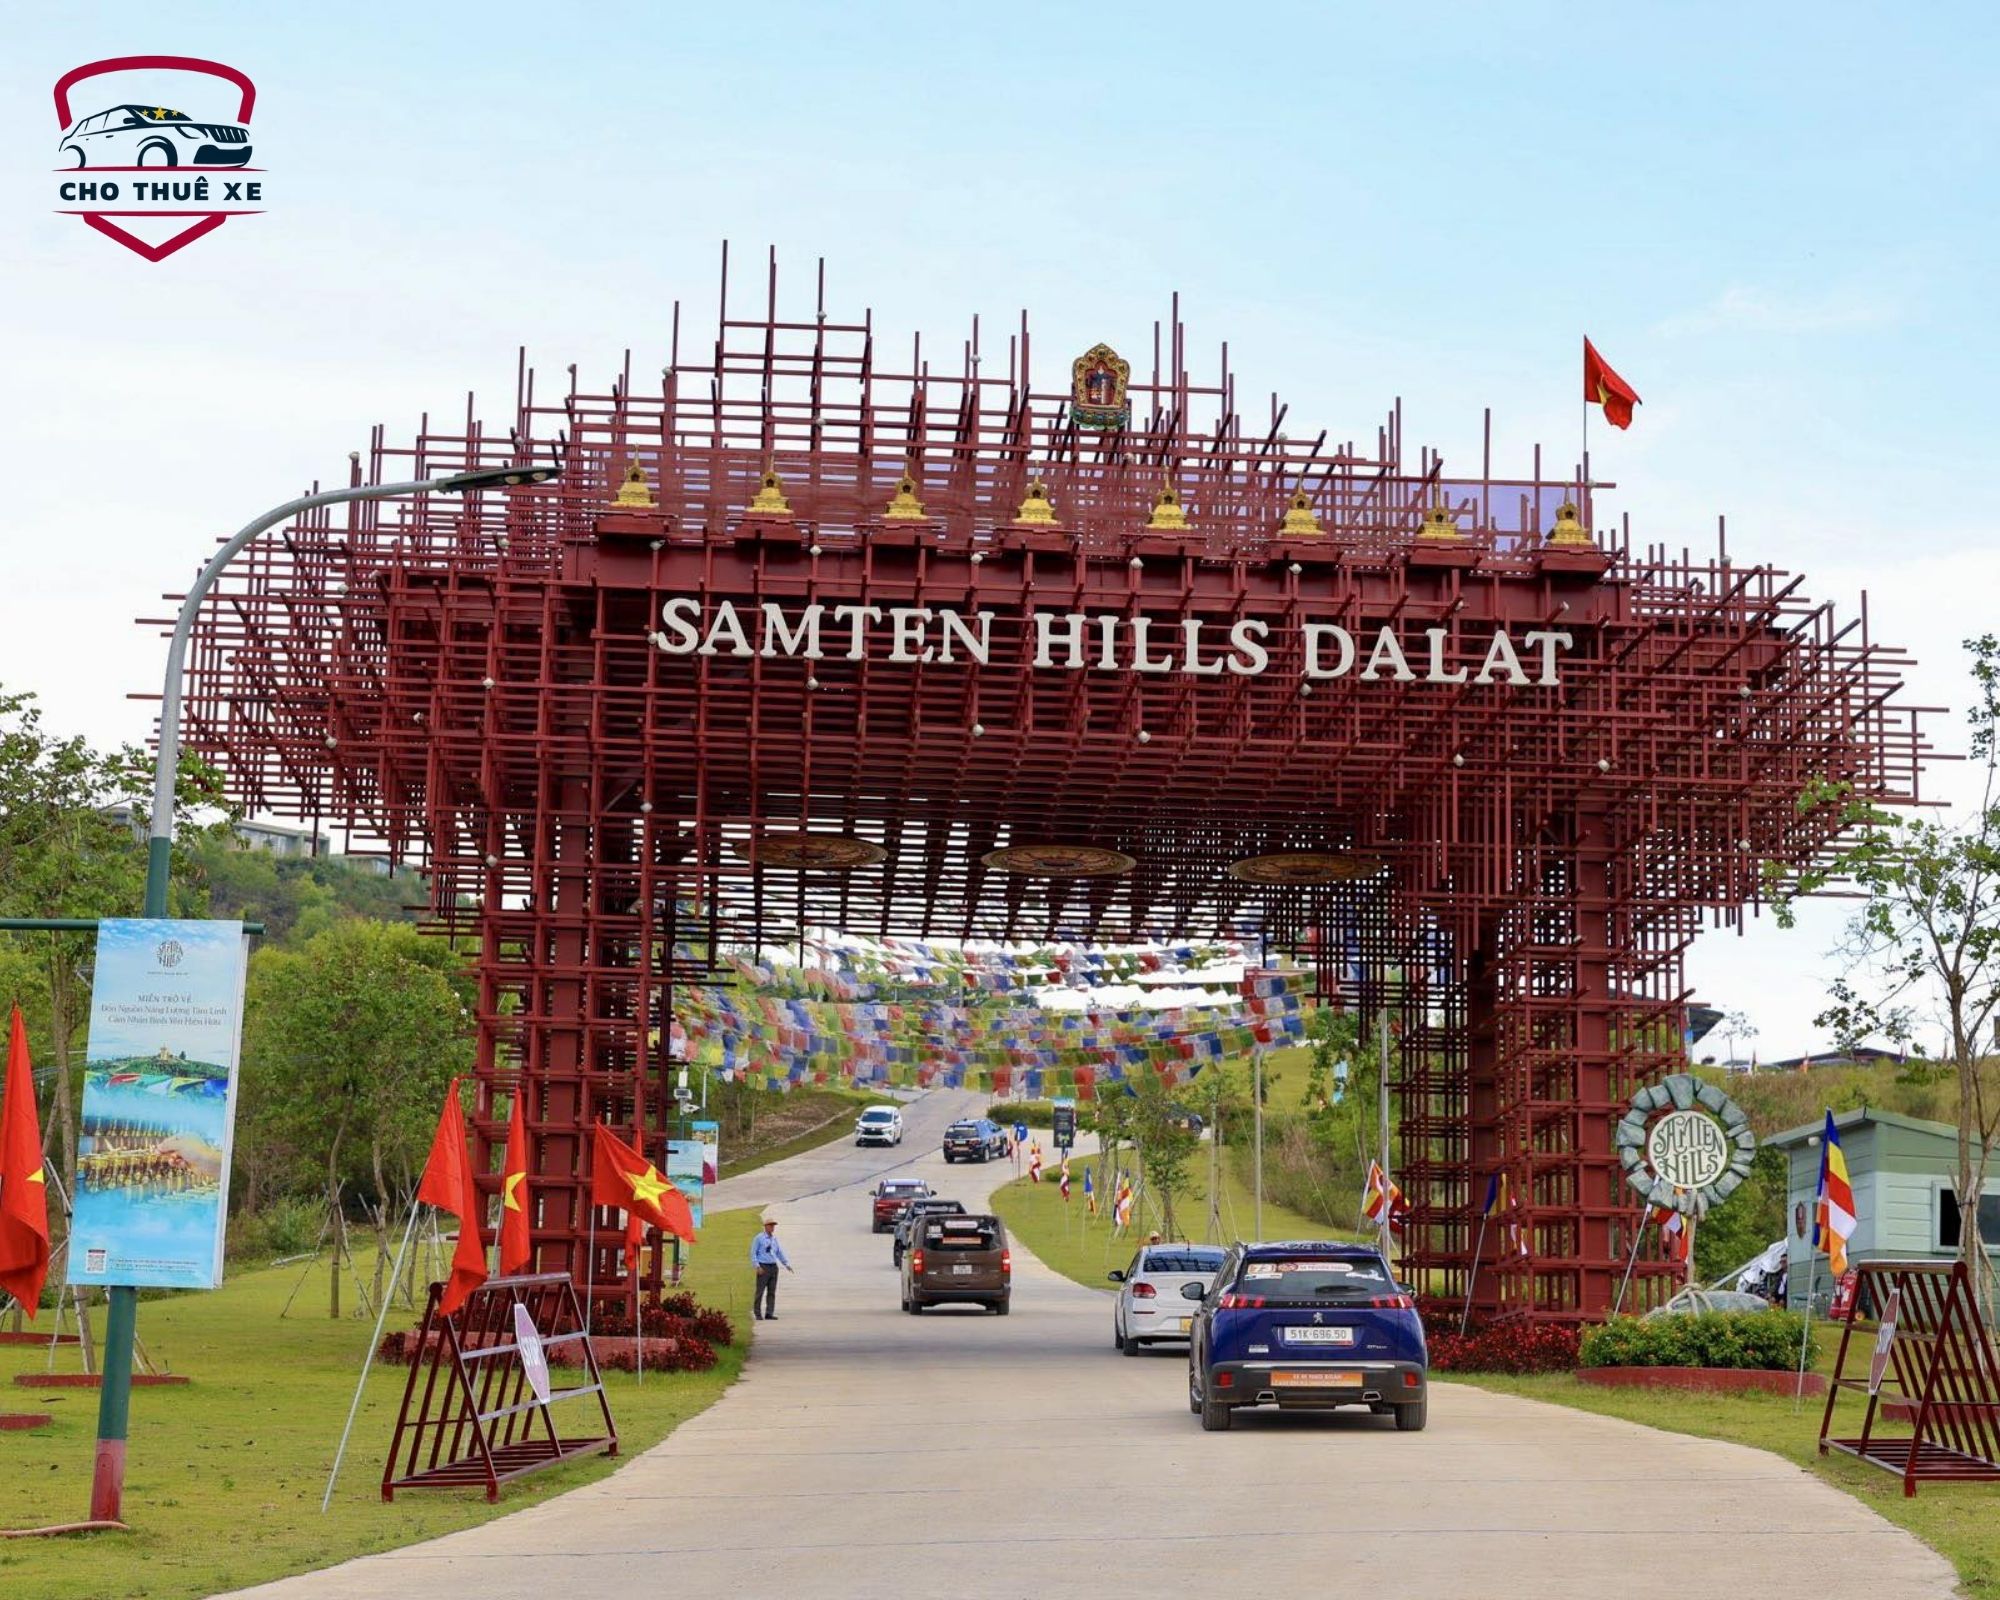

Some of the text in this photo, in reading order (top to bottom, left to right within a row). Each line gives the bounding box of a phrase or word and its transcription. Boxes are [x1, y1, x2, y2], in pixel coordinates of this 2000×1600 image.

[656, 597, 1574, 686] SAMTEN HILLS DALAT
[1653, 1115, 1723, 1157] SAMTEN
